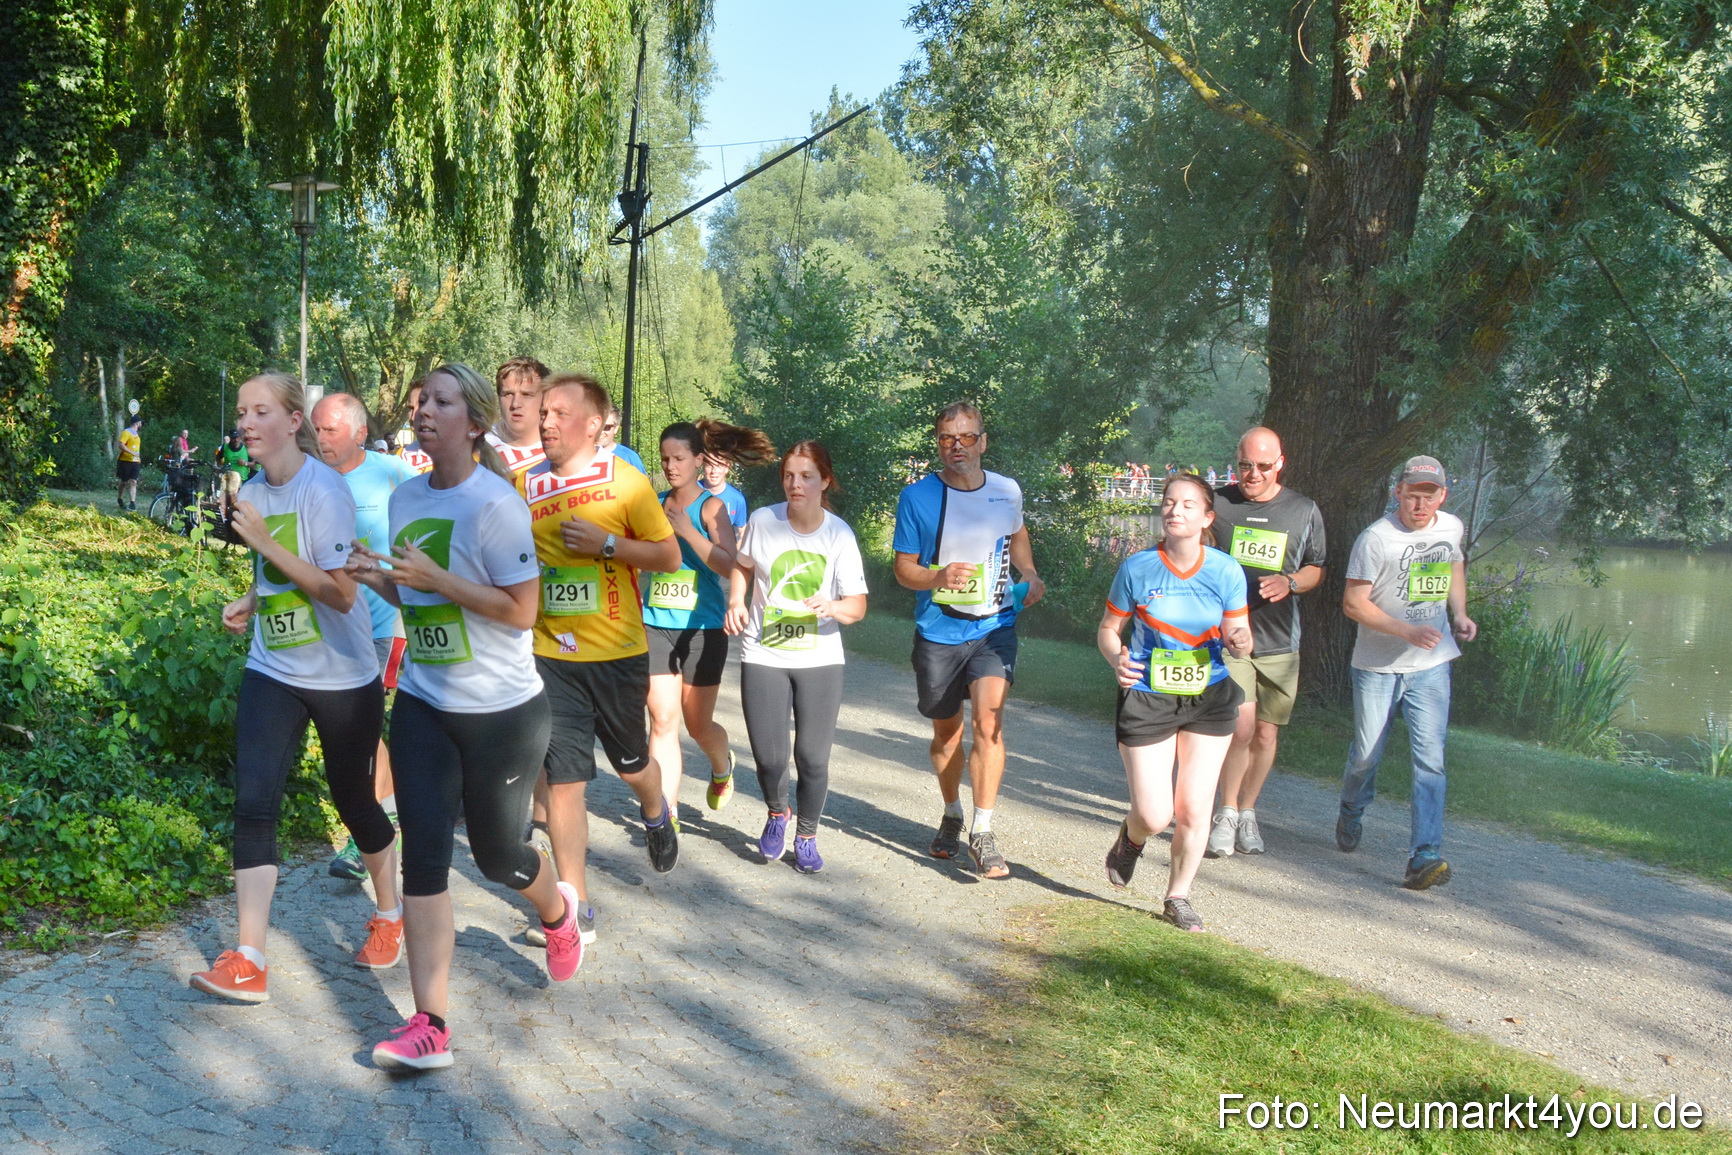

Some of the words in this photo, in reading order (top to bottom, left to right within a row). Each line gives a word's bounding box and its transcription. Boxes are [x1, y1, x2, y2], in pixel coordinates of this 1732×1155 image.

[567, 489, 616, 509] BÖGL
[1239, 541, 1278, 559] 1645
[653, 581, 690, 598] 2030
[1417, 576, 1448, 590] 1678
[546, 584, 589, 601] 1291
[1405, 607, 1432, 619] SUPPLY
[266, 611, 296, 634] 157
[775, 622, 806, 639] 190
[414, 626, 449, 648] 160
[1160, 665, 1205, 682] 1585
